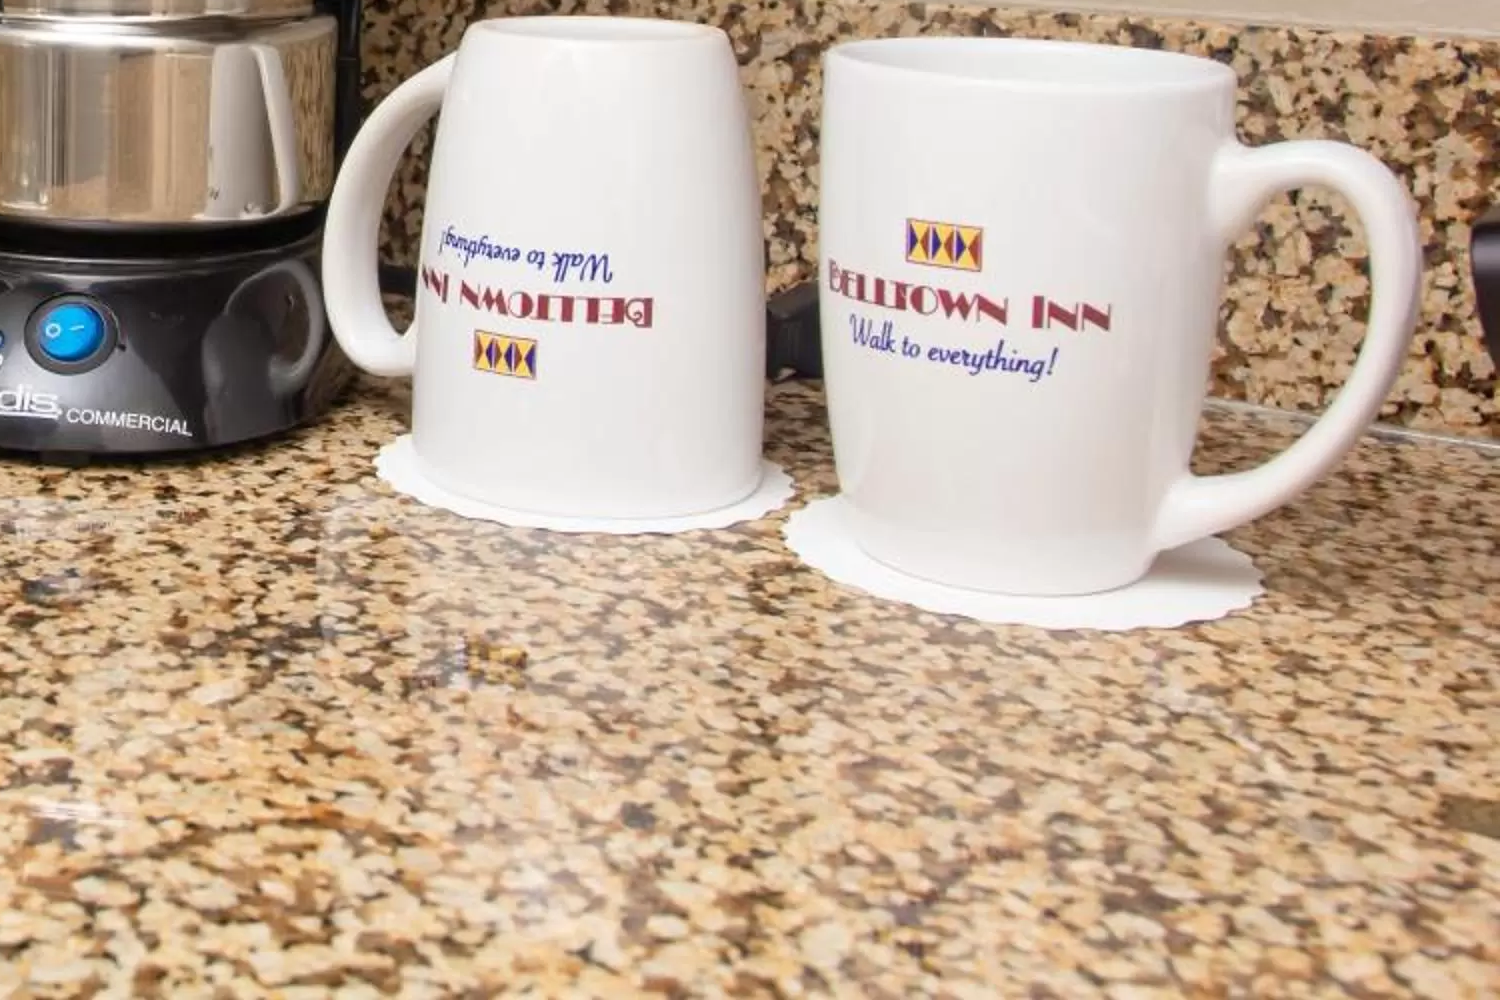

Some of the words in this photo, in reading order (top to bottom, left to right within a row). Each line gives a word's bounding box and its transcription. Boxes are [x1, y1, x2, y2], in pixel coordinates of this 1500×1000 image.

[439, 226, 521, 268] everything!
[527, 250, 546, 269] to
[552, 253, 613, 284] Walk
[459, 279, 654, 329] BELLTOWN
[828, 258, 1009, 326] BELLTOWN
[1031, 295, 1112, 332] INN
[850, 313, 897, 354] Walk
[902, 334, 921, 358] to
[927, 339, 1059, 383] everything!
[66, 407, 193, 437] COMMERCIAL
